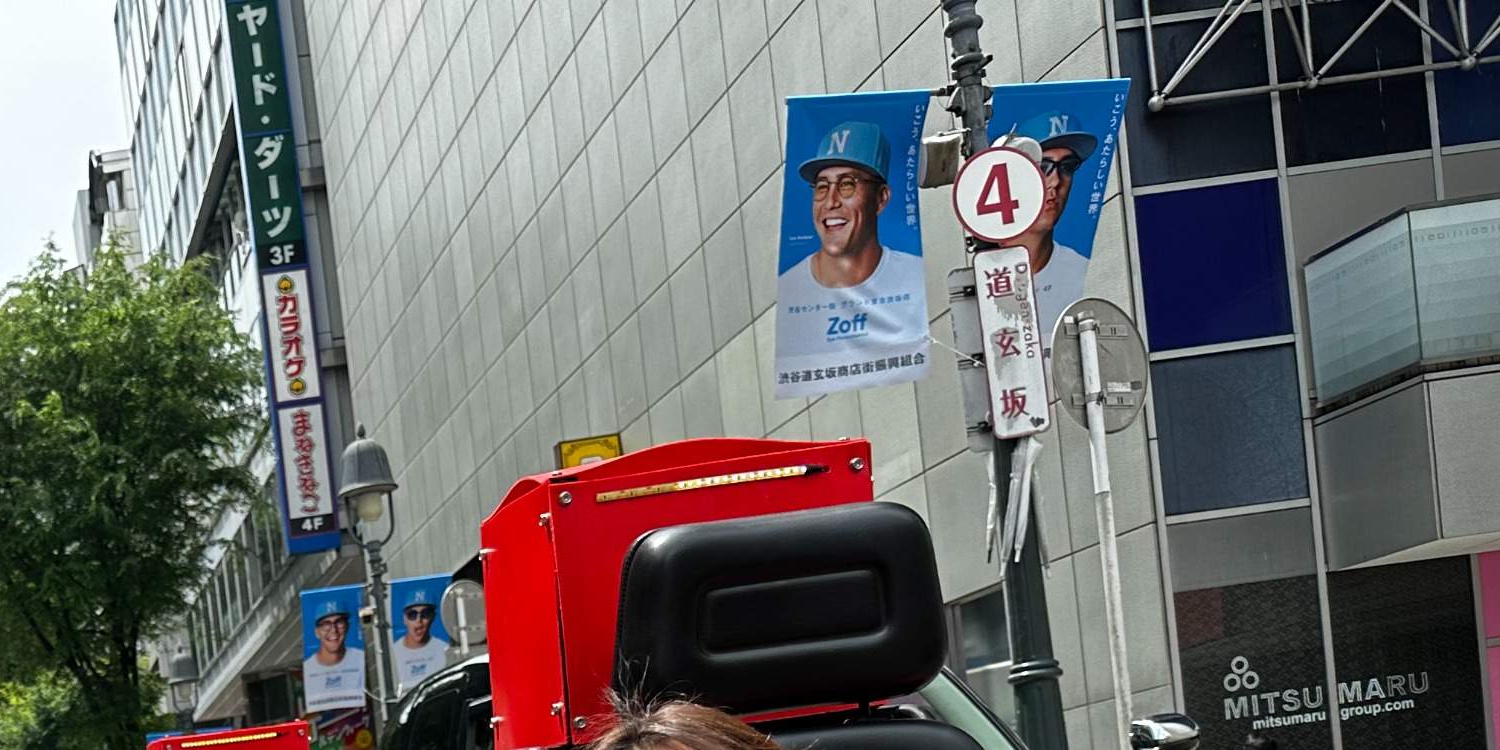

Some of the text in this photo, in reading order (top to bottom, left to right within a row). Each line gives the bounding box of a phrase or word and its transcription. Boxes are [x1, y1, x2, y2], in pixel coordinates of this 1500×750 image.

[236, 4, 292, 238] ヤード・ダーツ
[827, 129, 850, 156] N
[1049, 115, 1068, 137] N
[976, 162, 1020, 226] 4
[269, 245, 295, 265] 3F
[276, 295, 306, 379] カラオケ
[826, 312, 869, 336] Zoff
[984, 266, 1030, 419] 道玄坂
[291, 408, 320, 514] まねきねこ
[301, 517, 324, 532] 4F
